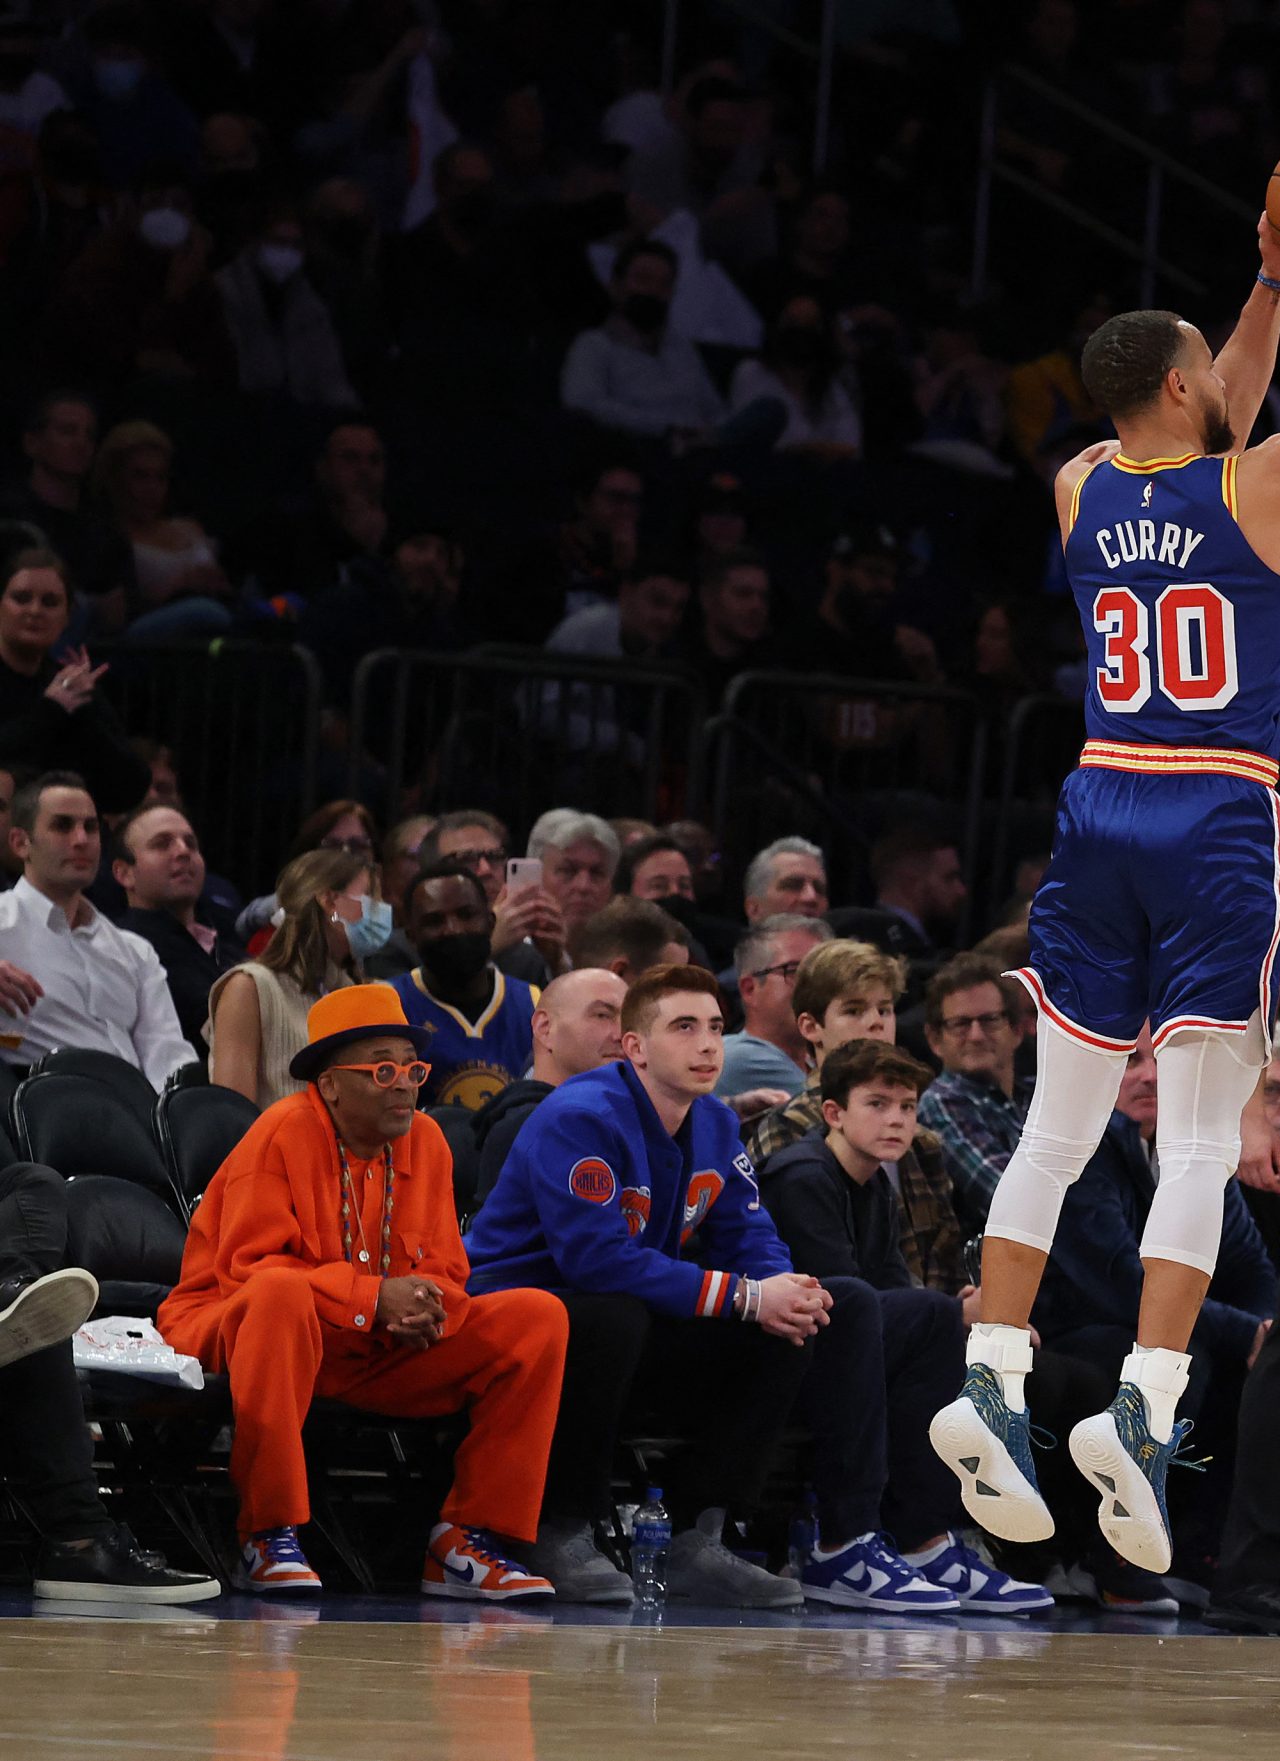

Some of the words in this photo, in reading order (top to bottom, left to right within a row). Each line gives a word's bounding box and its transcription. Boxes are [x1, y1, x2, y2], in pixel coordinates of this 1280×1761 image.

[1096, 519, 1205, 569] CURRY
[1093, 583, 1239, 713] 30
[576, 1171, 611, 1192] KNICKS
